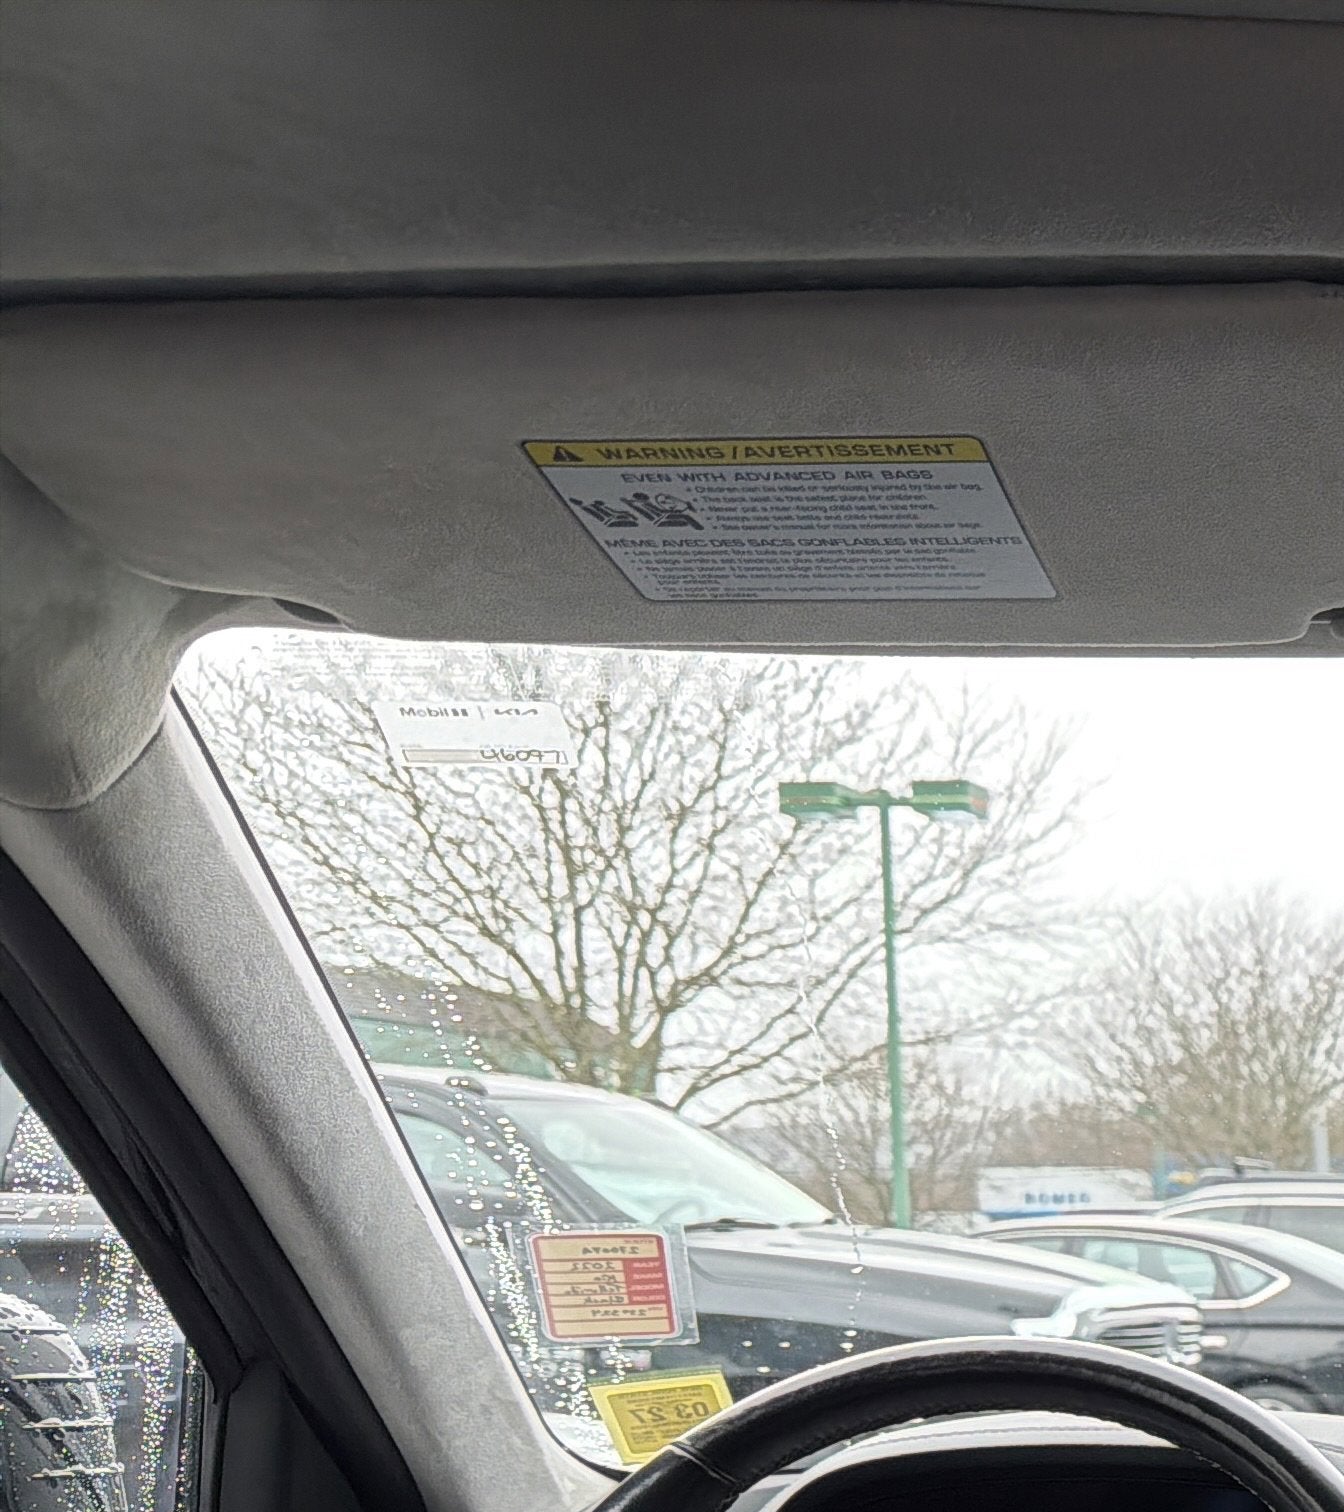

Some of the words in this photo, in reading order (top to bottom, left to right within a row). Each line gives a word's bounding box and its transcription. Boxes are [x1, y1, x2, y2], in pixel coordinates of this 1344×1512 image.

[596, 446, 725, 461] WARNING
[621, 471, 673, 484] EVEN
[678, 470, 727, 483] WITH
[734, 470, 837, 483] ADVANCED
[844, 469, 876, 482] AIR
[882, 468, 934, 481] BAGS
[662, 537, 705, 548] AVEC
[708, 537, 745, 548] DES
[748, 537, 795, 548] SACS
[798, 536, 908, 548] GONFLABLES
